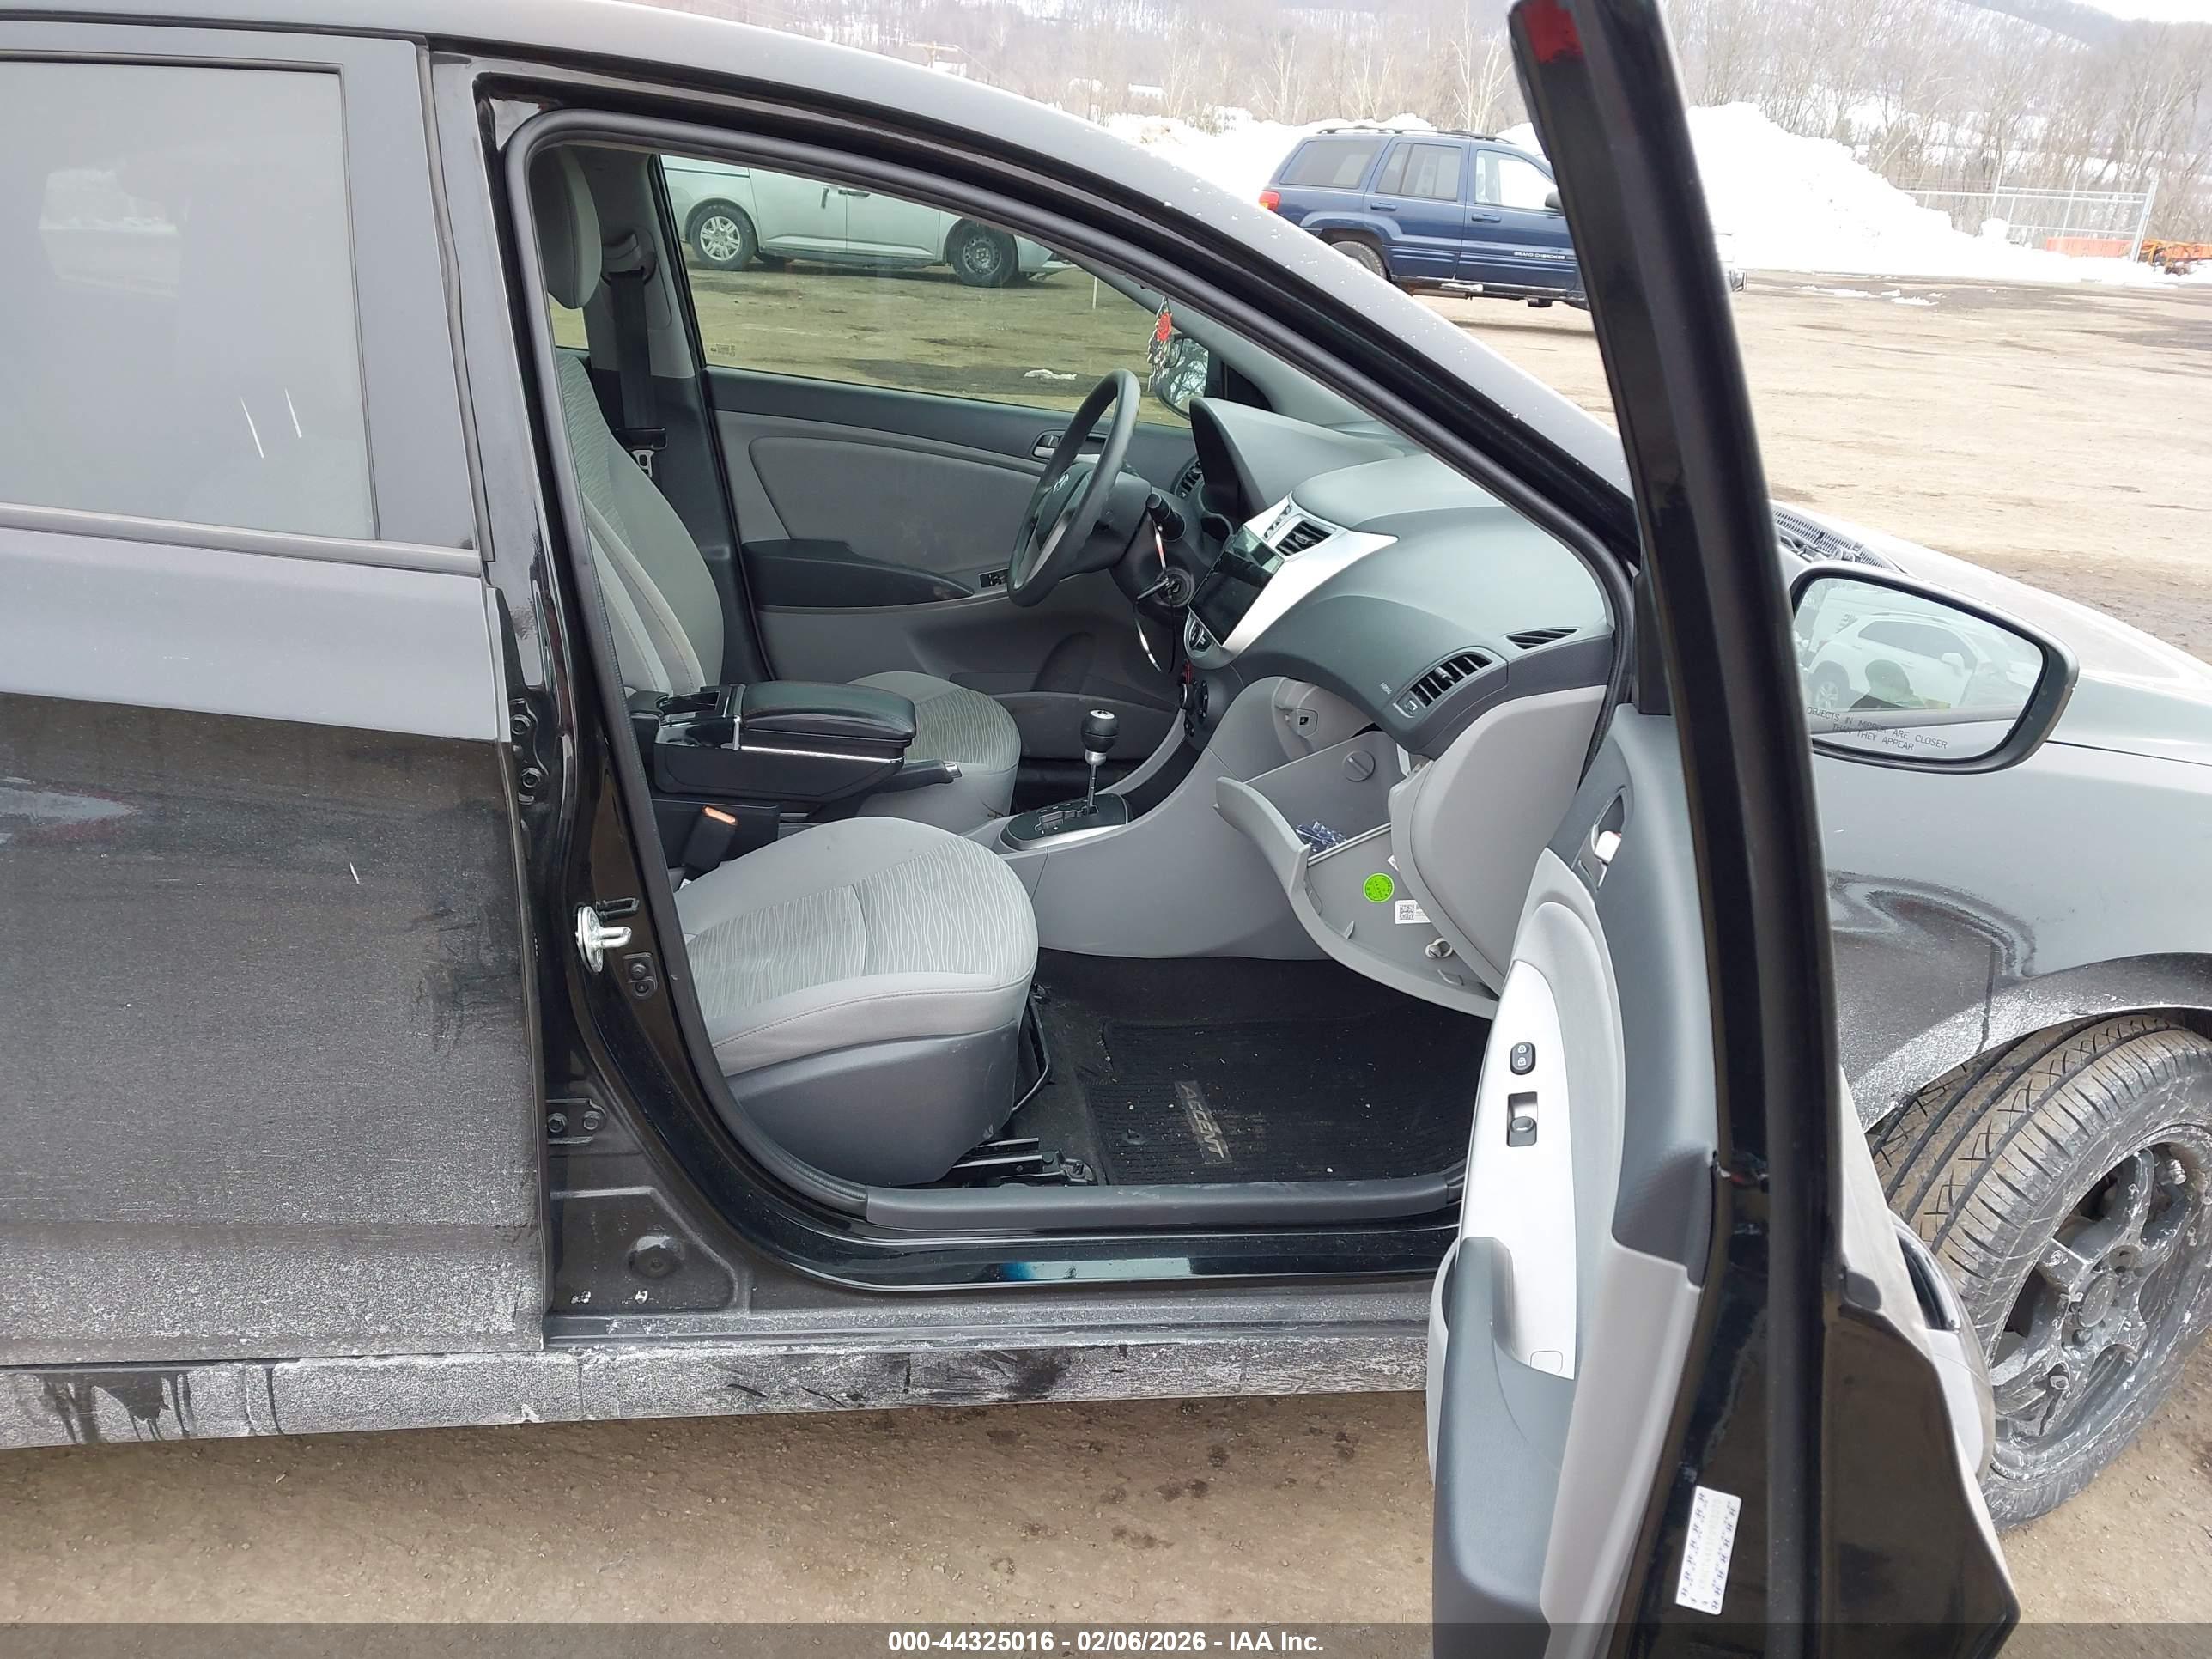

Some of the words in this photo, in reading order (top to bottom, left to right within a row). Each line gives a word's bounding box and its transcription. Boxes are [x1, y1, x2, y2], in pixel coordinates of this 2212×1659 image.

[1807, 707, 1840, 722] OBJECTS
[1846, 716, 1853, 725] IN
[1859, 720, 1887, 733] MIRROR
[1892, 729, 1910, 739] ARE
[1915, 735, 1948, 749] CLOSER
[1832, 723, 1851, 734] THAN
[1856, 731, 1876, 742] THEY
[1882, 738, 1915, 751] APPEAR
[1180, 1084, 1224, 1158] ACCENT
